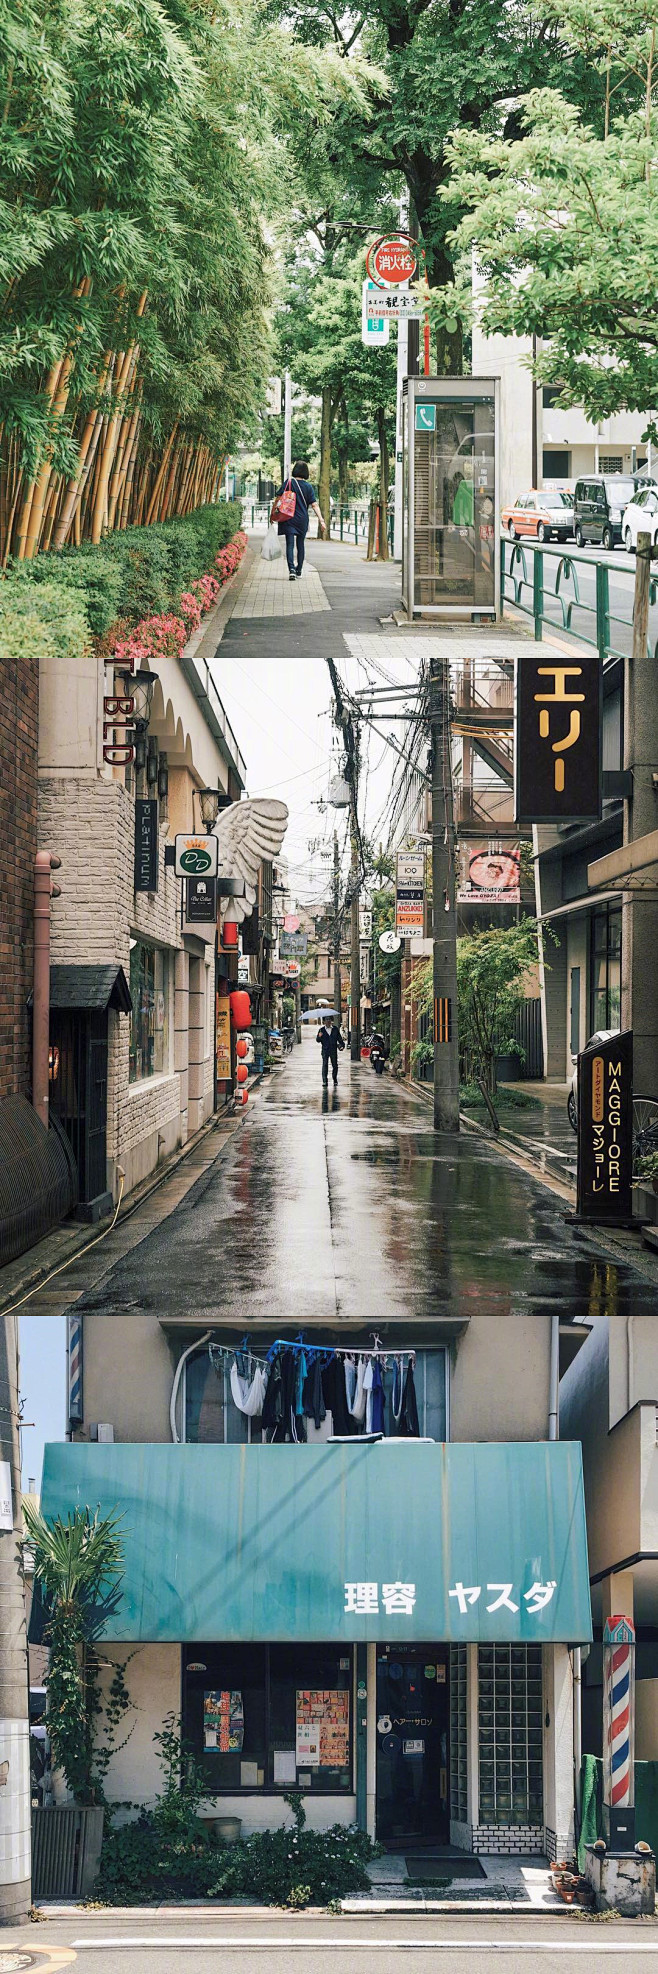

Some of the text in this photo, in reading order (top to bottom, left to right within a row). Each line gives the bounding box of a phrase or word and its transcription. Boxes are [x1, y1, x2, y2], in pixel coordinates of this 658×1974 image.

[379, 255, 412, 271] 消火栓
[104, 697, 134, 766] BLD
[533, 667, 586, 792] エリー
[592, 1124, 605, 1192] マジョーレ
[608, 1061, 622, 1192] MAGGIORE
[343, 1580, 558, 1615] 理容 ヤスダ
